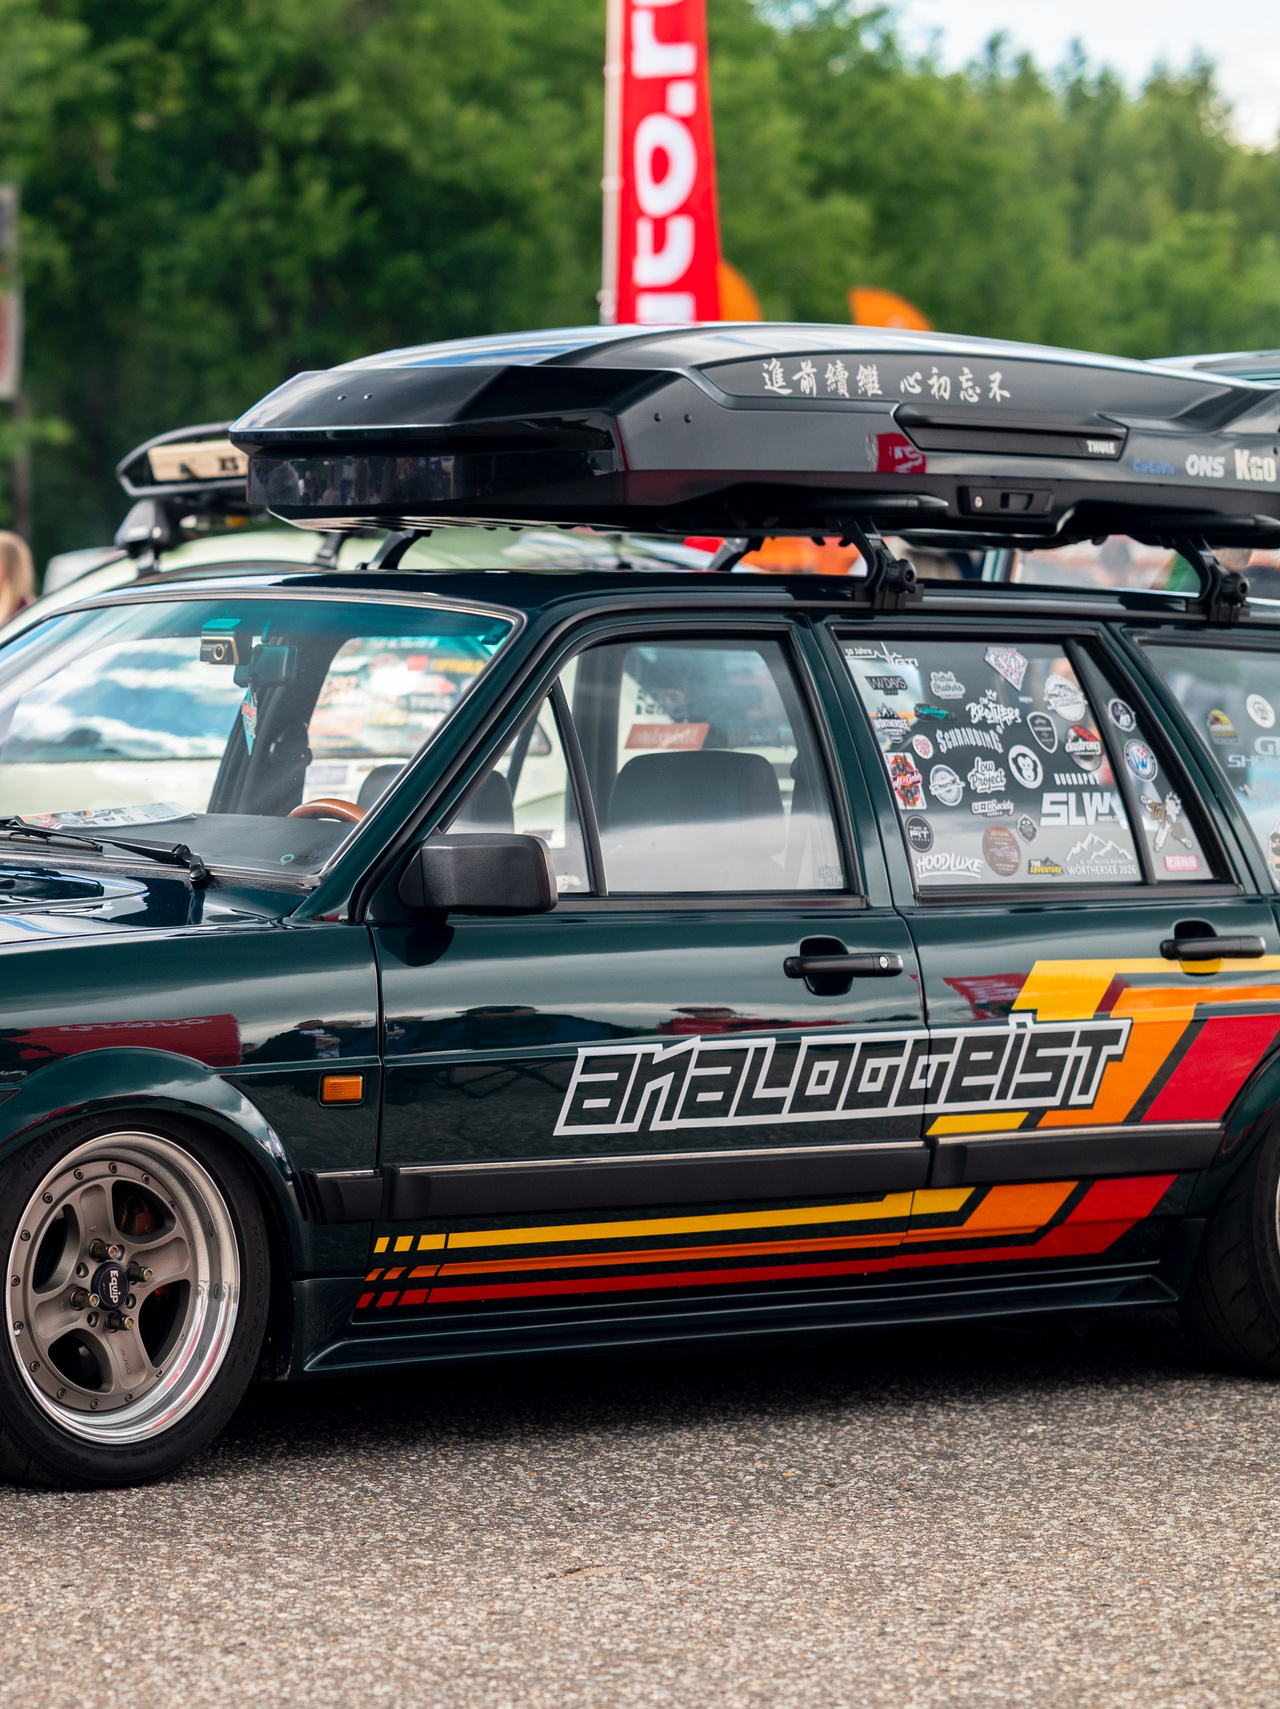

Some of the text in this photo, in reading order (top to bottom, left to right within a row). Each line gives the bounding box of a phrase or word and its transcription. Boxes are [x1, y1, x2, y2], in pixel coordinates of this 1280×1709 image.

[631, 0, 697, 323] to.r
[1086, 440, 1116, 454] THULE
[1185, 454, 1226, 478] ONS
[970, 769, 1004, 788] Project
[1040, 792, 1111, 826] SLW
[1029, 866, 1062, 874] ADVENTURE
[1066, 863, 1117, 875] WÖRTHERSEE
